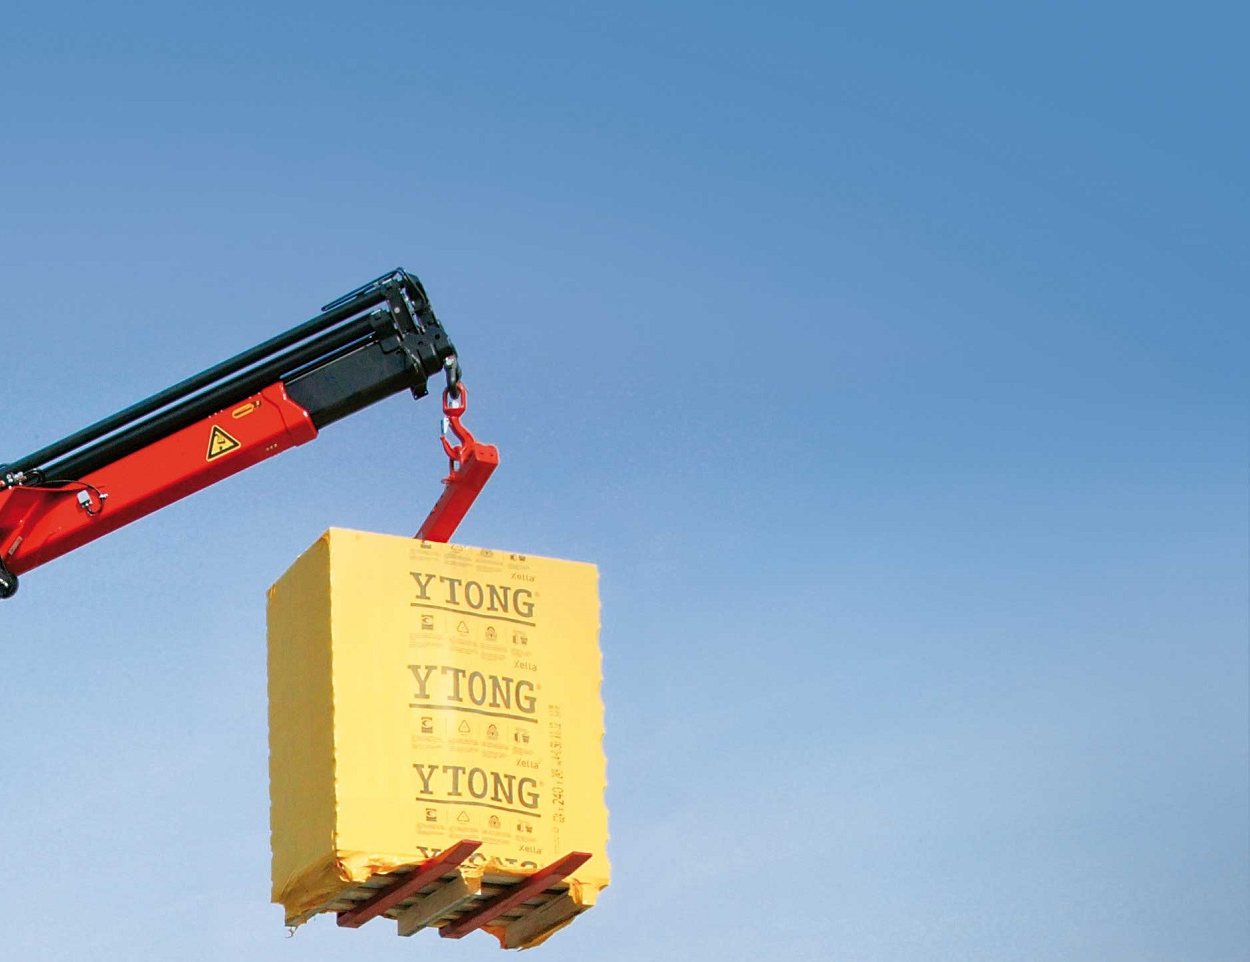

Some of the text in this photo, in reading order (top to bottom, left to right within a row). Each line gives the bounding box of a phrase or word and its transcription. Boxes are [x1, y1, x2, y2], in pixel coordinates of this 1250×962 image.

[409, 571, 536, 618] YTONG
[407, 664, 538, 714] YTONG
[413, 763, 541, 810] YTONG
